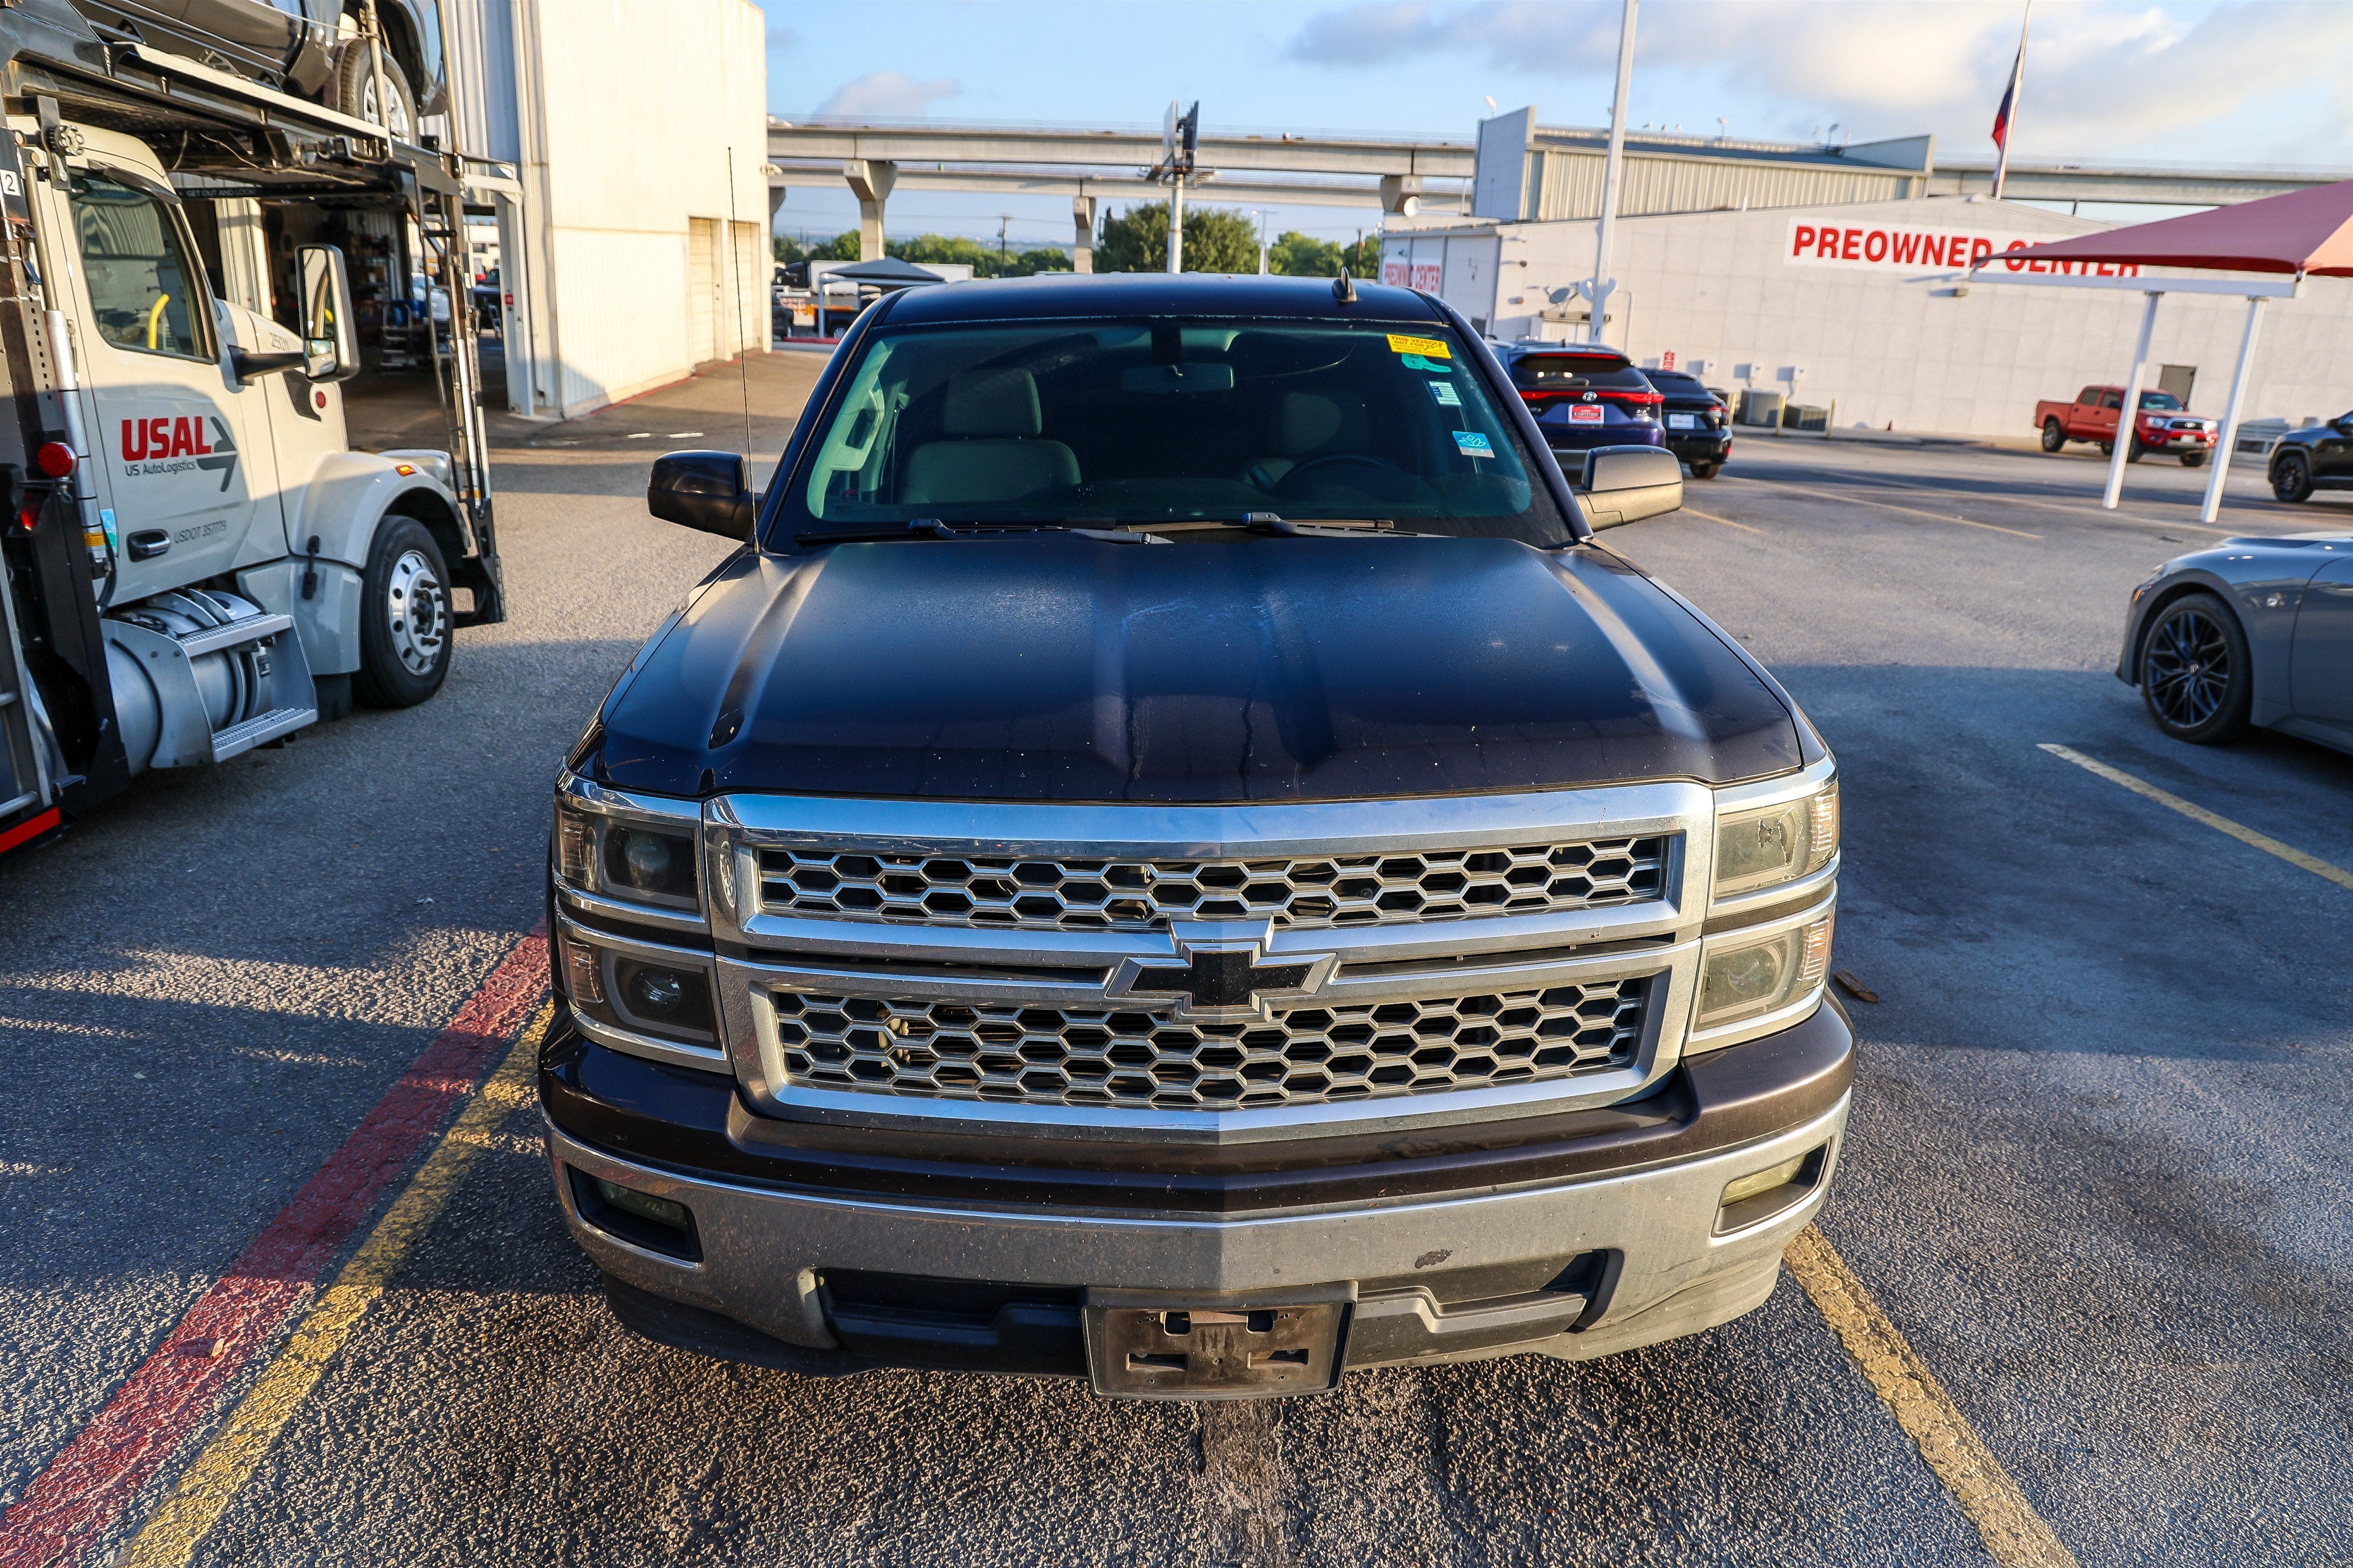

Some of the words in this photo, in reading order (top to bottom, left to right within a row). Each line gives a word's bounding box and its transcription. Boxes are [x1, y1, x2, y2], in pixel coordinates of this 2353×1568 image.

[5, 173, 16, 192] 2
[186, 189, 202, 197] GET
[202, 188, 217, 196] OUT
[1793, 226, 1992, 268] PREOWNED
[121, 416, 212, 462] USAL
[125, 464, 140, 476] US
[143, 460, 195, 475] AutoLogistics
[173, 526, 200, 544] USDOT
